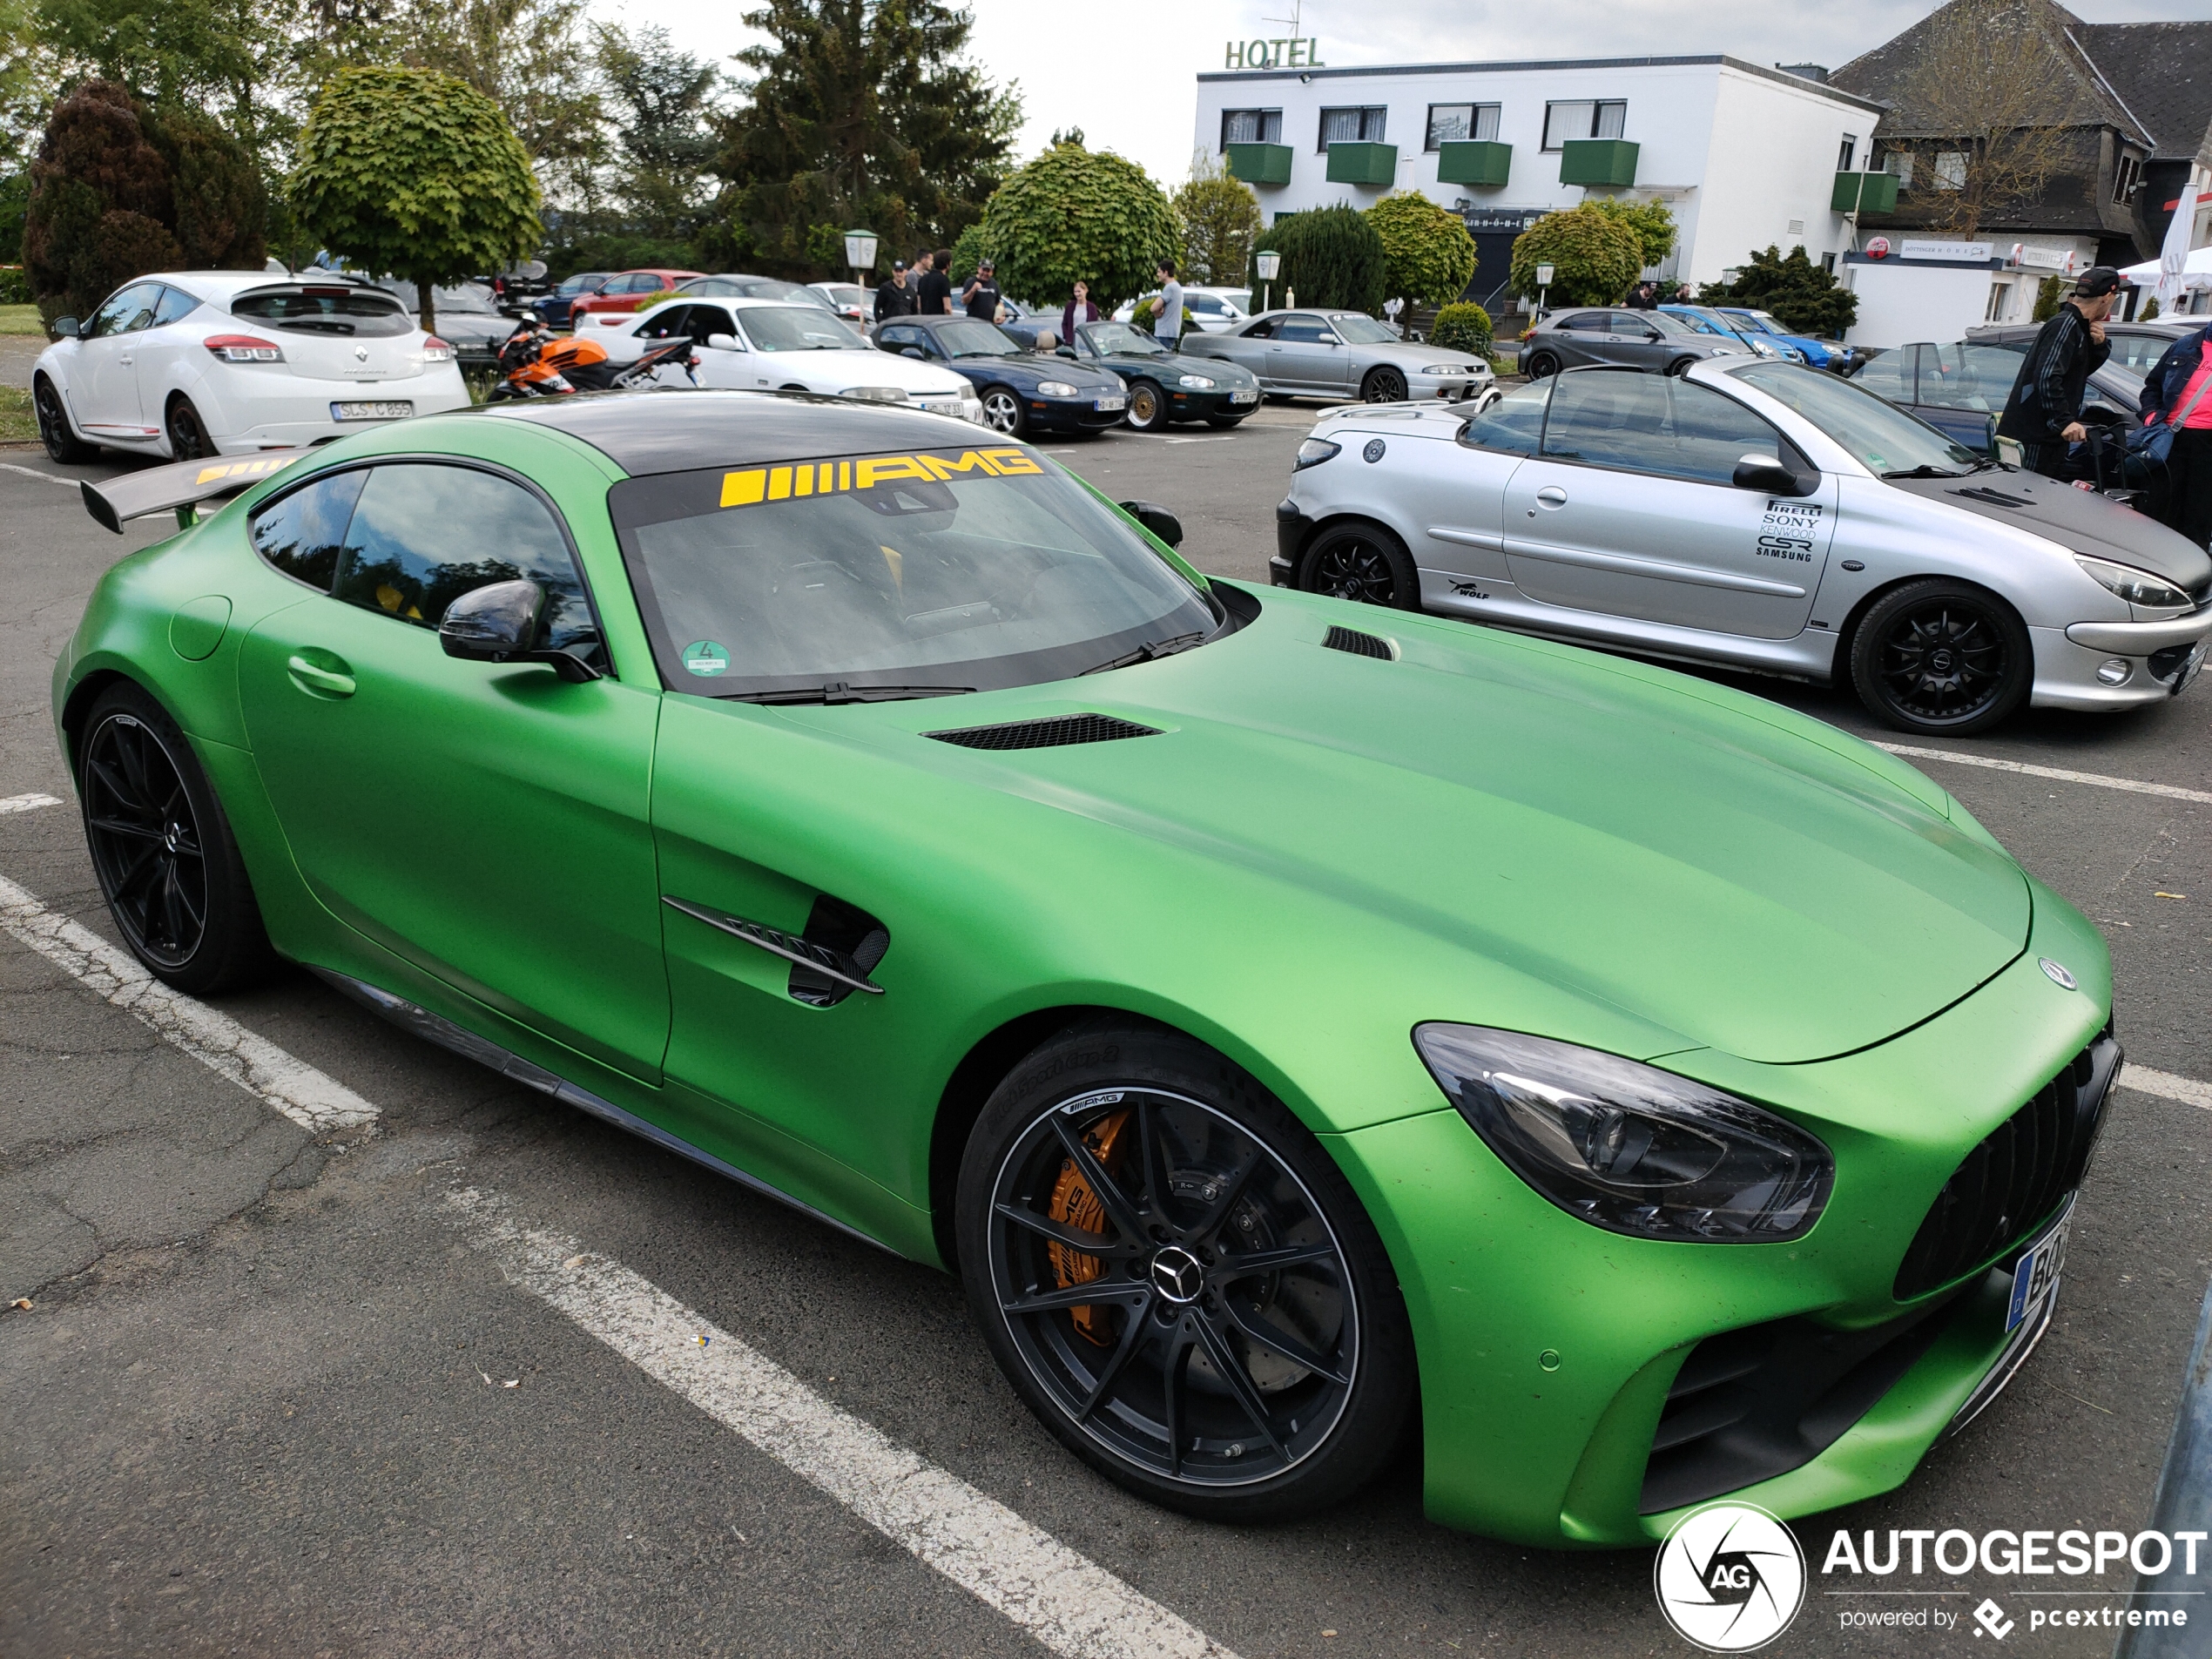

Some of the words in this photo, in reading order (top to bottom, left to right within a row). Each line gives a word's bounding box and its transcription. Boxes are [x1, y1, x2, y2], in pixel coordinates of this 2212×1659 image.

[1225, 37, 1325, 69] HOTEL
[341, 403, 368, 416] SLS
[855, 448, 1044, 489] AMG
[1766, 500, 1823, 516] PIRELLI
[1763, 514, 1819, 529] SONY
[1760, 524, 1816, 540] KENWOOD
[1758, 536, 1813, 552] CSR
[1756, 547, 1811, 563] SAMSUNG
[1460, 589, 1490, 599] WOLF
[699, 642, 713, 658] 4
